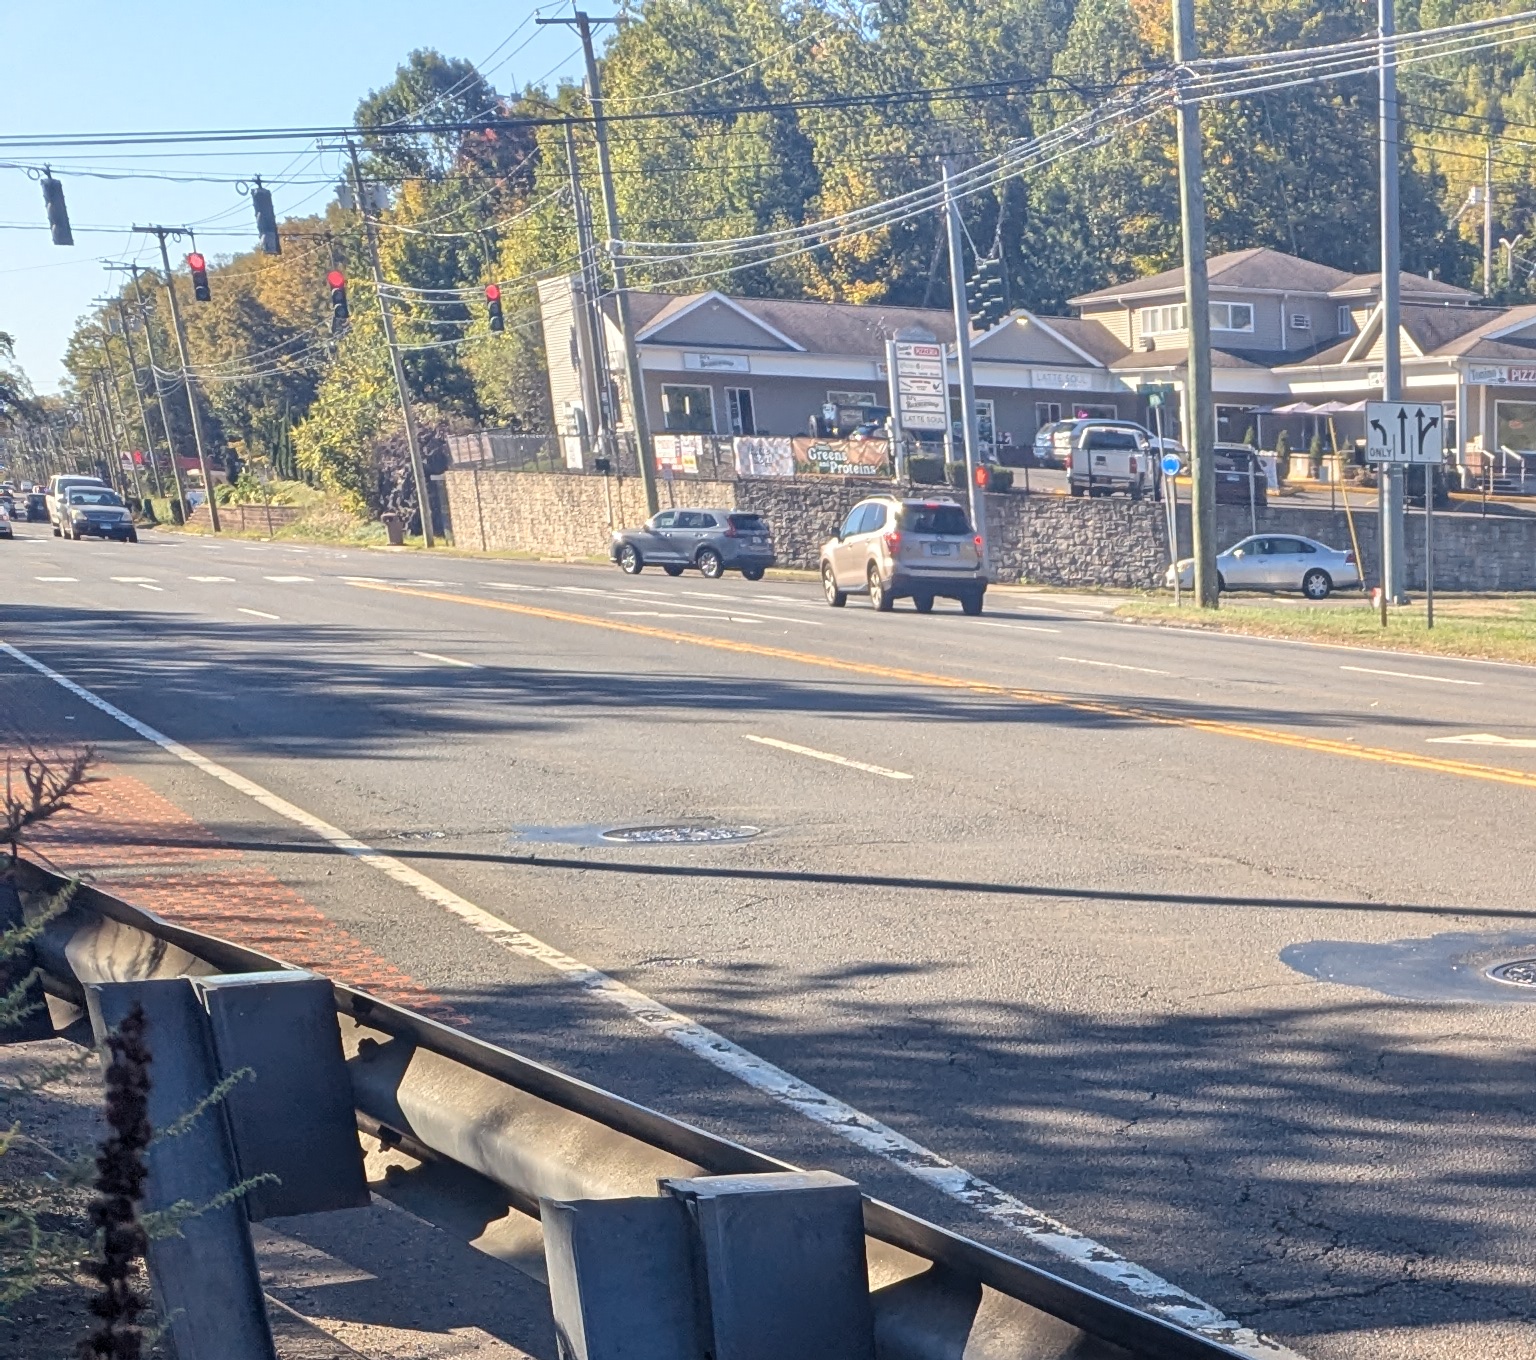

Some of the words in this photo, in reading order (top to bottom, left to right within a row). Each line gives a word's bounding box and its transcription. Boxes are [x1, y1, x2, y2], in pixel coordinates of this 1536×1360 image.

[807, 447, 848, 461] Greens
[1369, 448, 1393, 458] ONLY
[830, 461, 877, 474] Proteins
